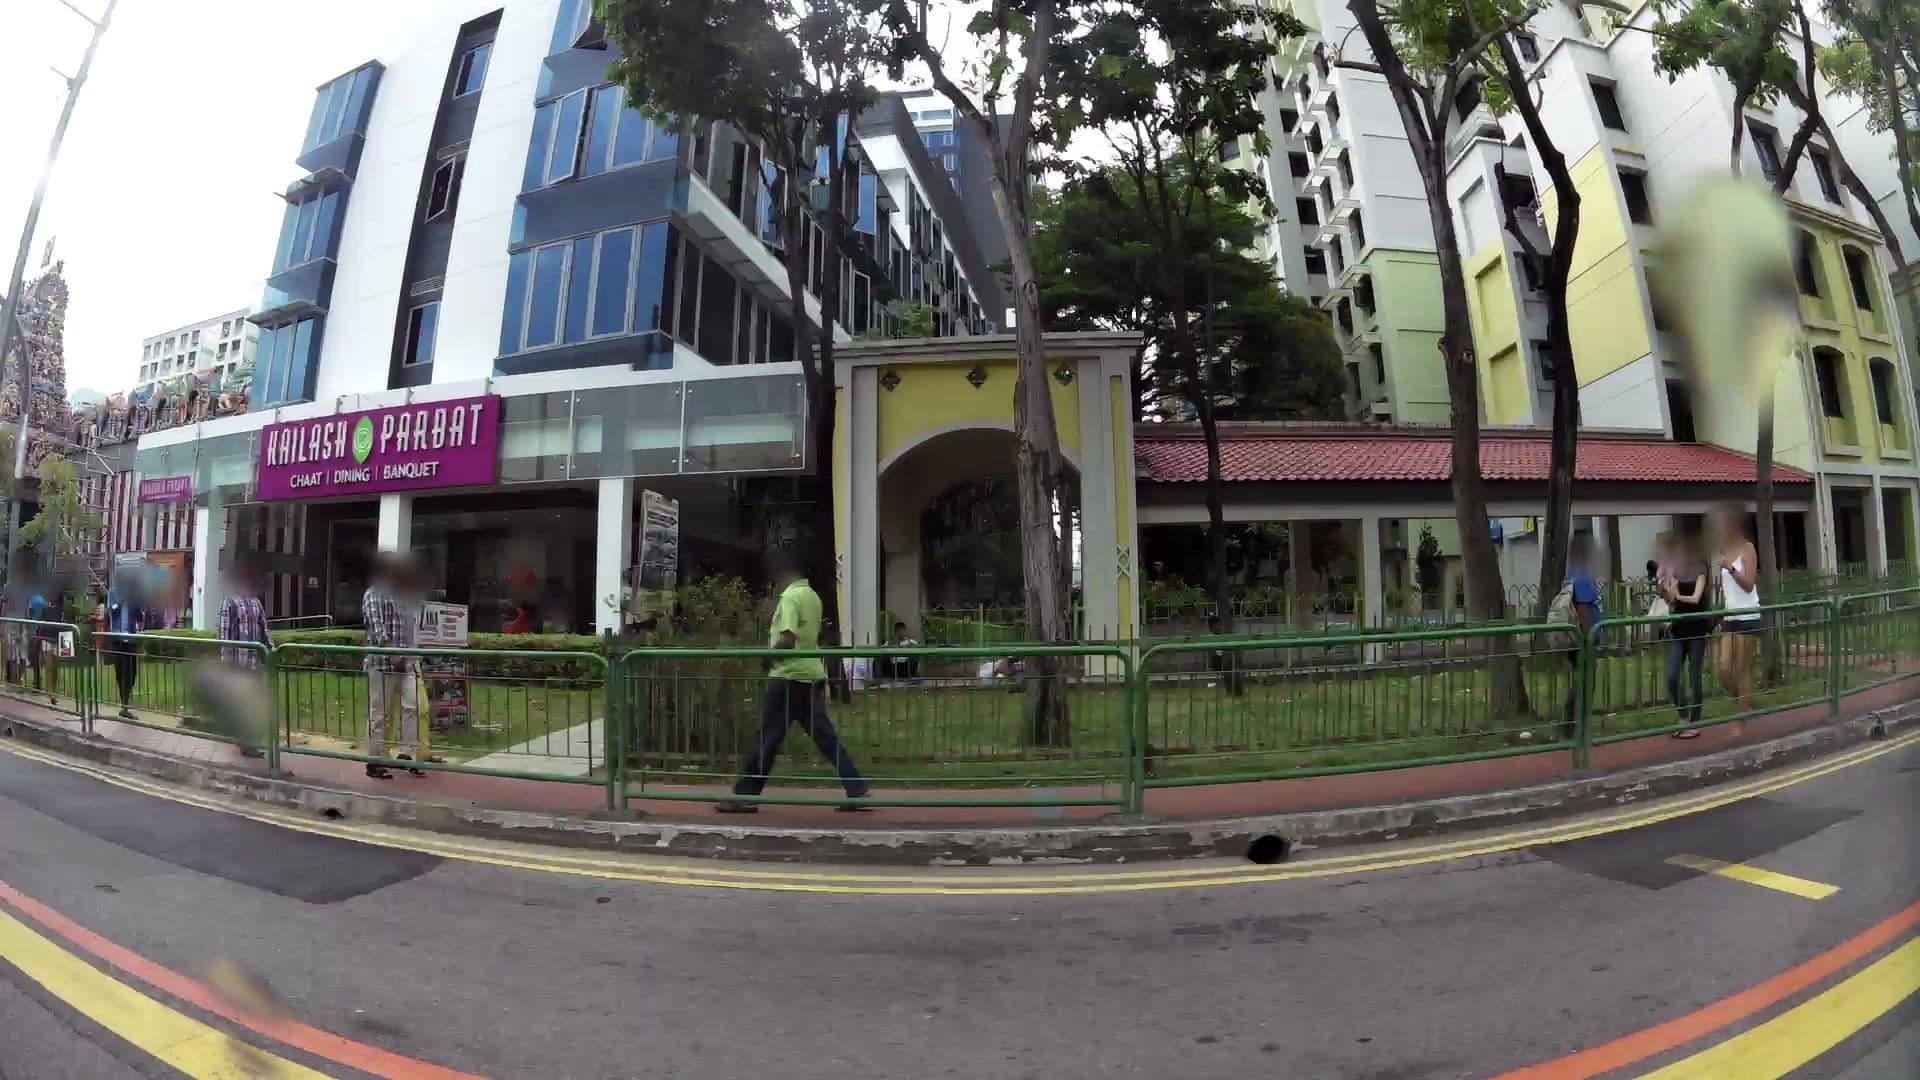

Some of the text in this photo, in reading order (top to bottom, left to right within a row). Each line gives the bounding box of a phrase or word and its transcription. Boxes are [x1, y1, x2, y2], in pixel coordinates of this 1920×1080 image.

[267, 404, 483, 466] KAILASH PARBAT
[290, 461, 439, 488] CHAAT DINING BANQUET
